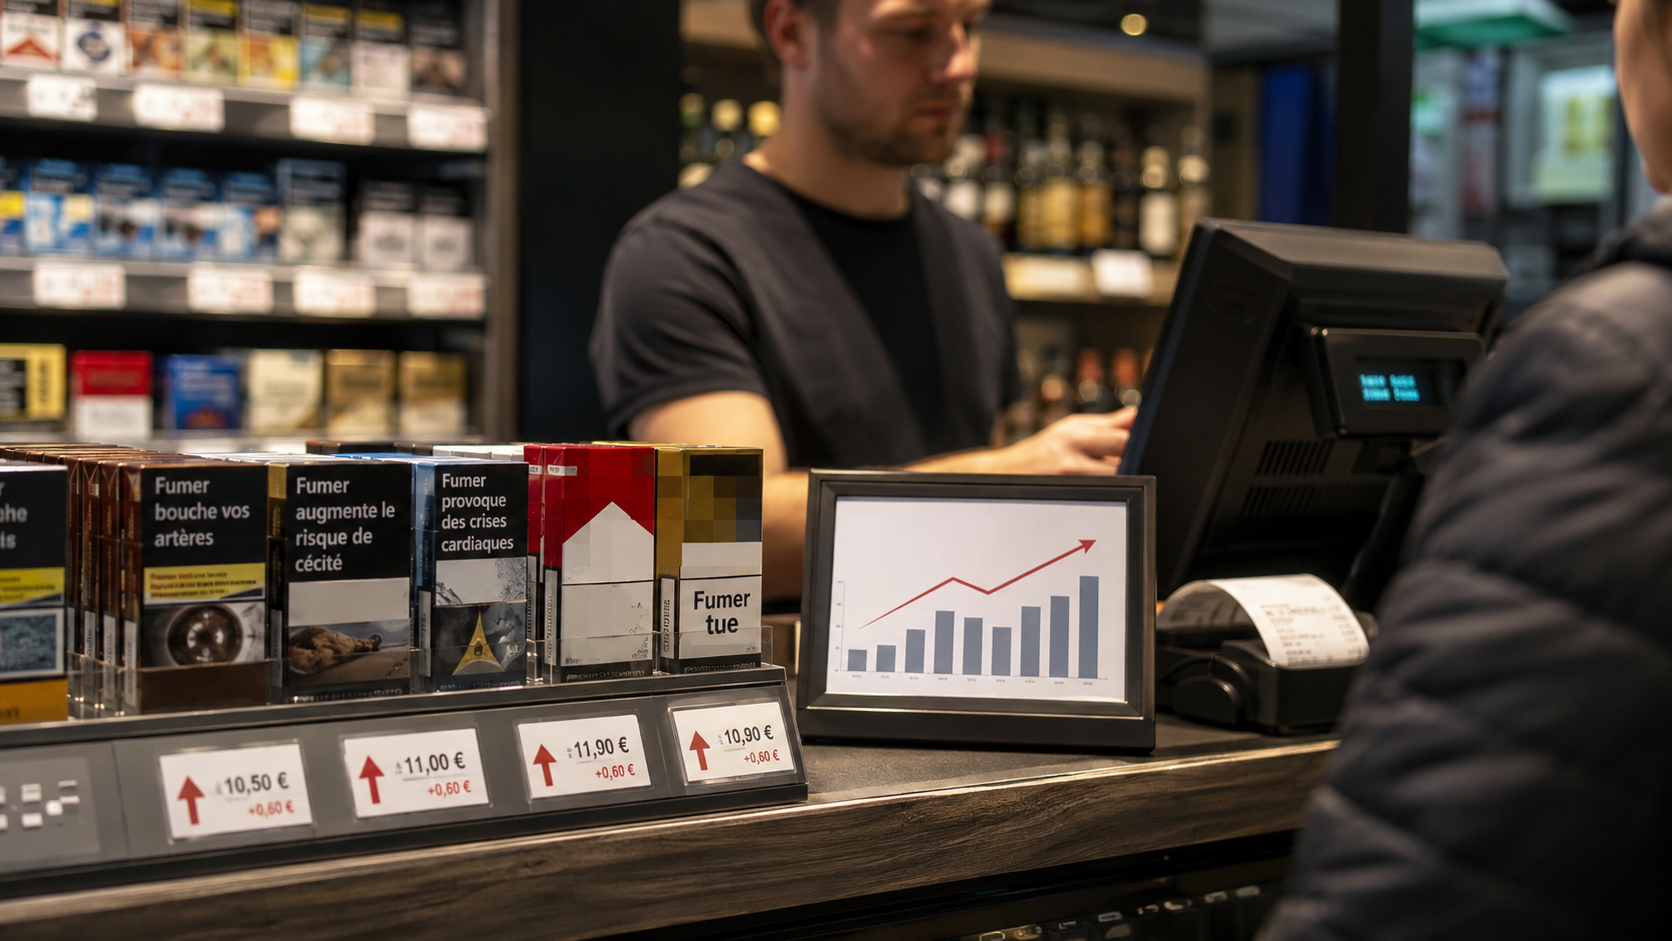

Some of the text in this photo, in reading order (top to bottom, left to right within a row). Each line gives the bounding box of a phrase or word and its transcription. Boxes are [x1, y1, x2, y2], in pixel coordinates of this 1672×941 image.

[155, 476, 210, 494] Fumer
[296, 477, 350, 495] Fumer
[442, 473, 487, 488] Fumer
[155, 502, 250, 521] bouche vos
[295, 501, 396, 525] augmente le
[441, 495, 507, 513] provoque
[441, 514, 507, 530] des crises
[154, 528, 214, 547] artères
[296, 526, 373, 550] risque de
[441, 535, 514, 554] cardiaques
[295, 553, 343, 572] cécité
[693, 590, 751, 611] Fumer
[705, 614, 739, 636] tue
[724, 724, 775, 746] 10,90 €
[574, 736, 630, 760] 11,90 €
[744, 748, 781, 765] +0,60 €
[404, 751, 466, 776] 11,00 €
[595, 763, 636, 781] +0,60 €
[224, 771, 289, 797] 10,50 €
[427, 779, 473, 799] +0,60 €
[248, 799, 295, 818] +0,60 €
